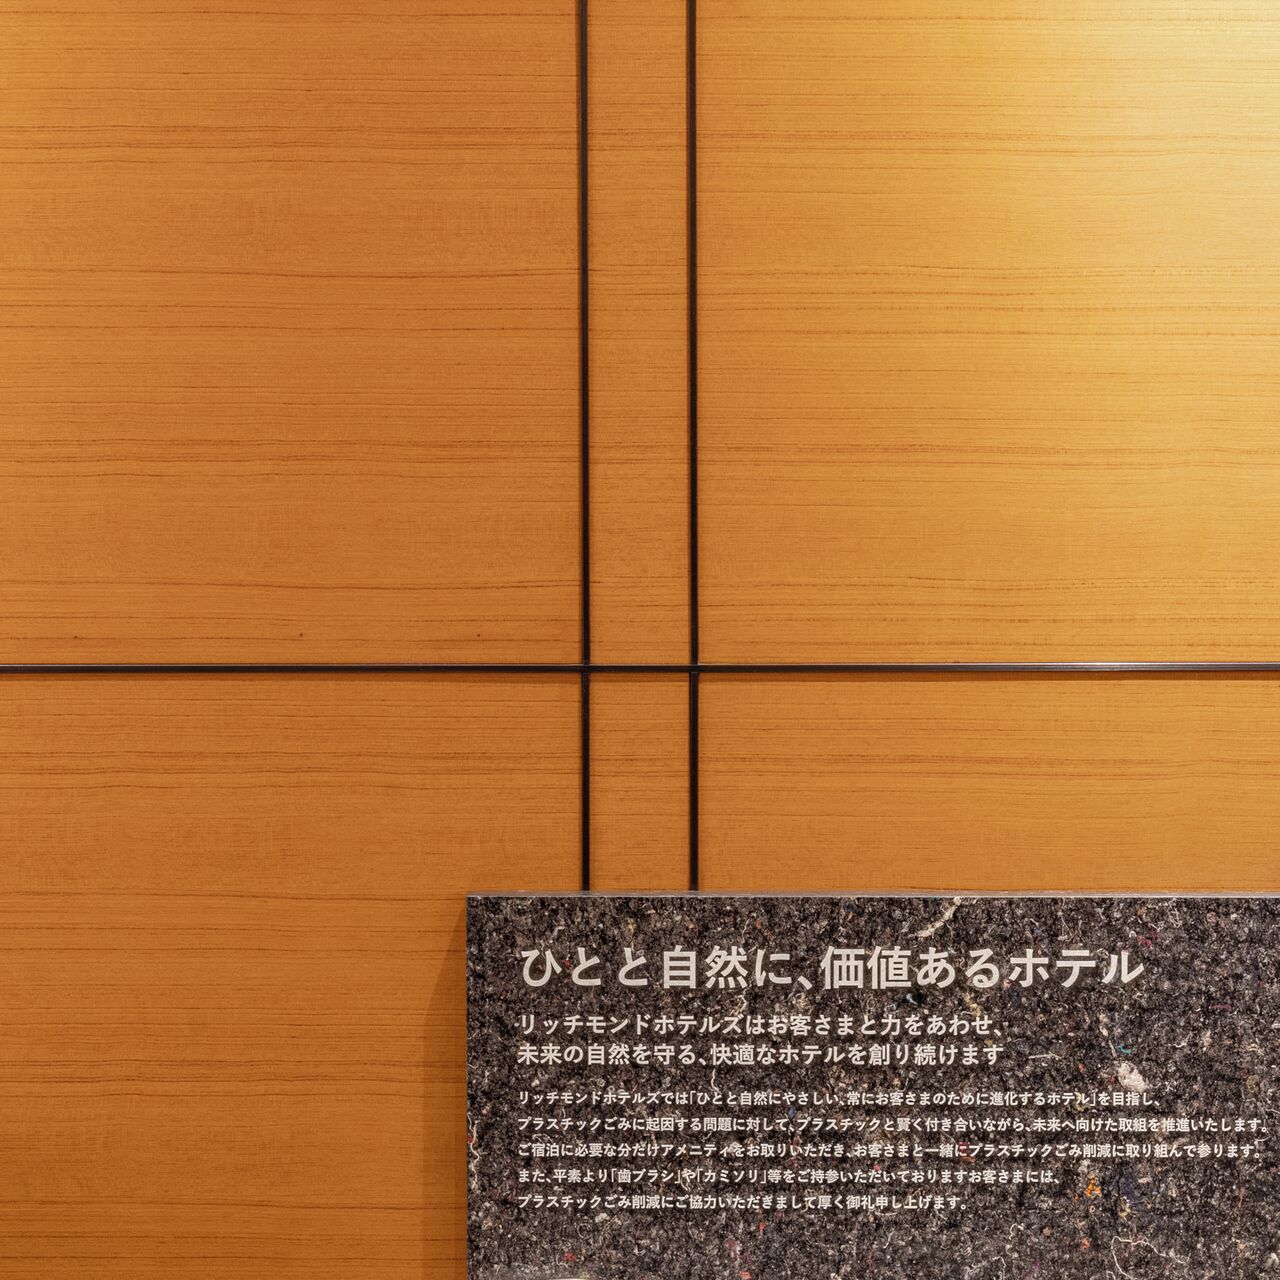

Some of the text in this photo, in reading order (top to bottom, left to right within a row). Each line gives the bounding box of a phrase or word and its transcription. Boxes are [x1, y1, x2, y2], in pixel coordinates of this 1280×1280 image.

[521, 945, 1144, 989] ひとと自然に、価値あるホテル
[519, 1014, 1001, 1036] リッチモンドホテルズはお客さまと力をあわせ、
[518, 1043, 1004, 1066] 未来の自然を守る、快適なホテルを創り続けます
